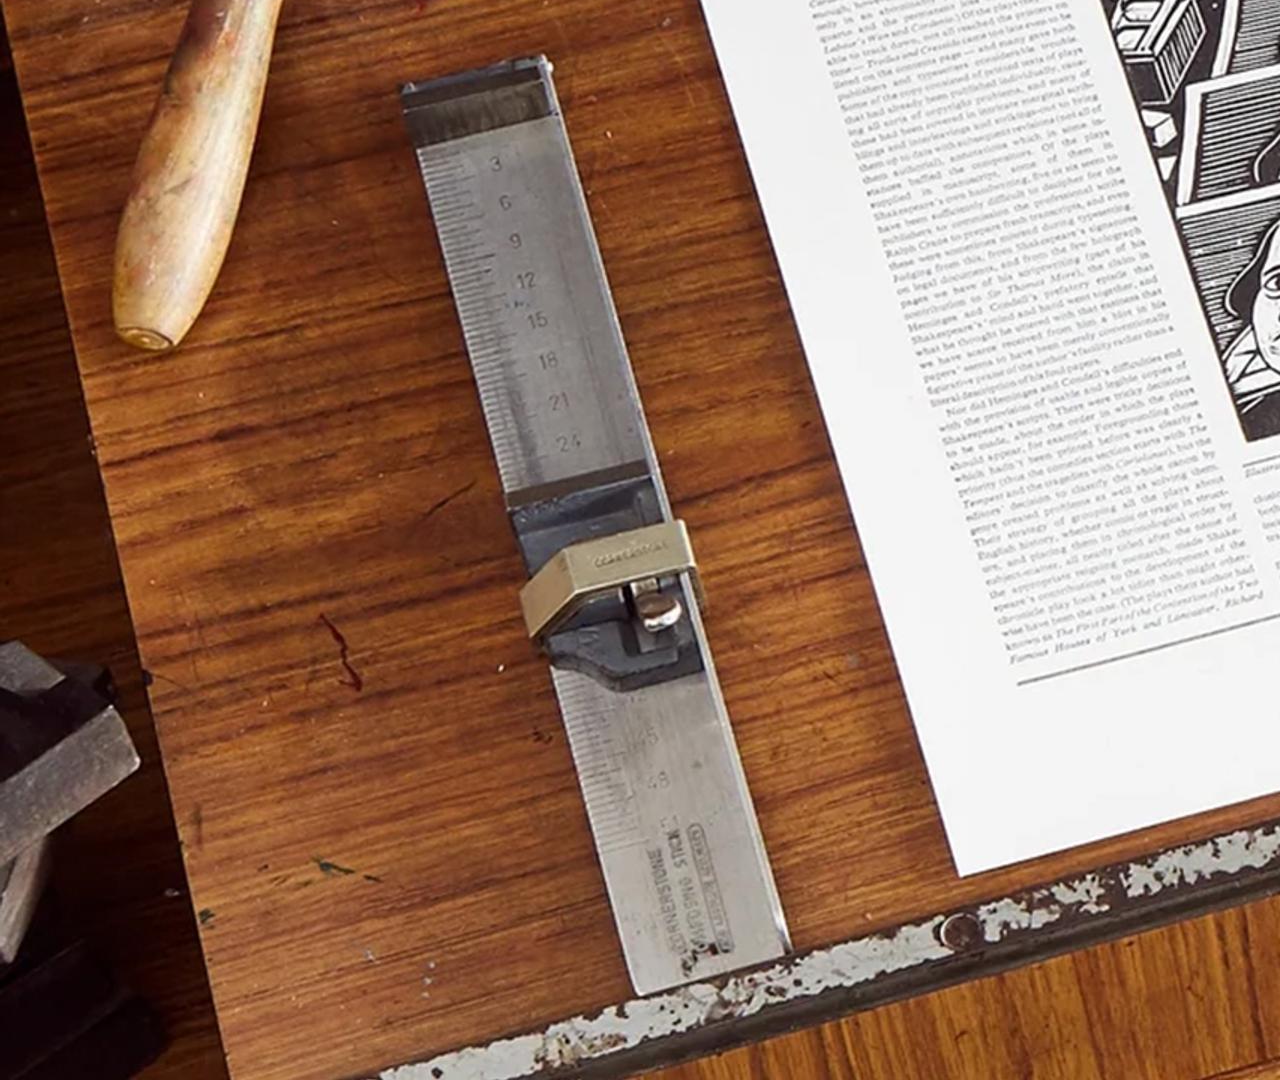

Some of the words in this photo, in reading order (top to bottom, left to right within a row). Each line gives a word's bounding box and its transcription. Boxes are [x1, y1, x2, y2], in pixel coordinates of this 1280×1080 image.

[491, 155, 502, 173] 3
[516, 272, 537, 289] 12
[527, 311, 548, 330] 15
[538, 351, 559, 369] 18
[1009, 648, 1050, 666] Famous
[1054, 637, 1092, 654] Houses
[1111, 623, 1138, 639] York
[1224, 589, 1265, 609] Richard
